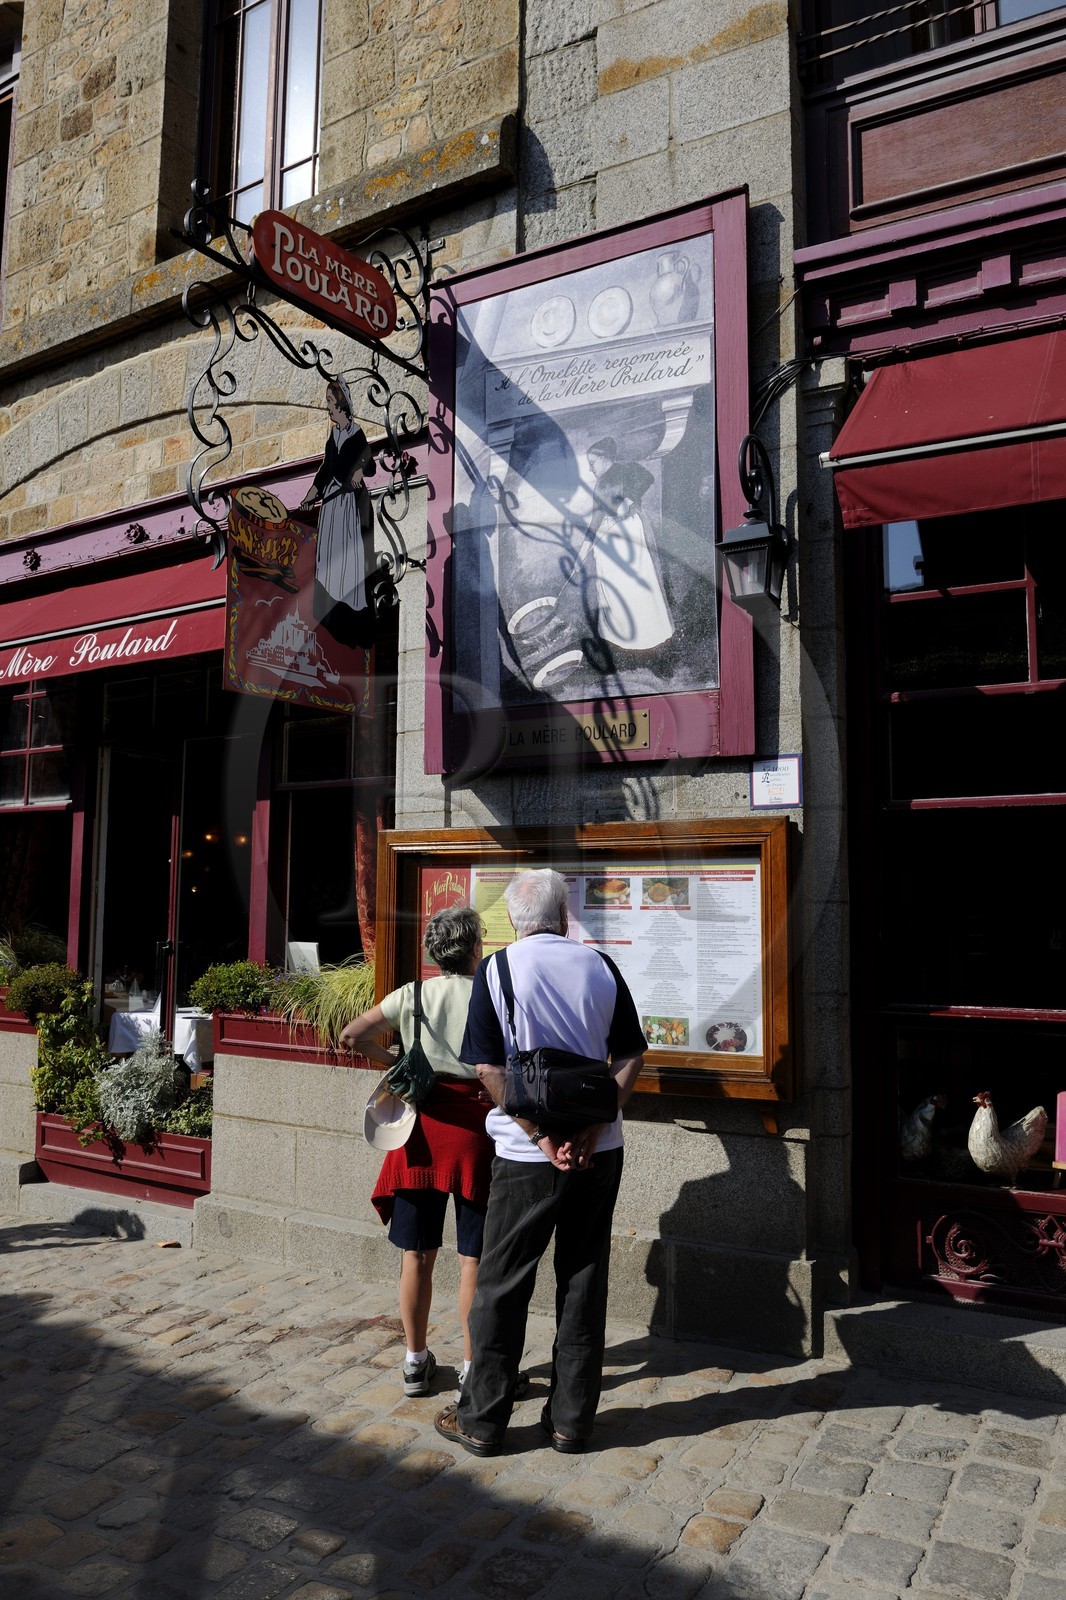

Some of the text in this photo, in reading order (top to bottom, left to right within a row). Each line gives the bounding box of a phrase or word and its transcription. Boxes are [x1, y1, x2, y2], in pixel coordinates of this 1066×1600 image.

[272, 221, 389, 332] POULARD
[298, 233, 378, 299] LA MERE
[515, 356, 597, 387] l'Omelette
[603, 341, 694, 370] renommée
[517, 390, 535, 407] de
[538, 382, 554, 402] la
[0, 619, 178, 680] Mère Poulard
[509, 722, 637, 746] LA MÈRE POULARD
